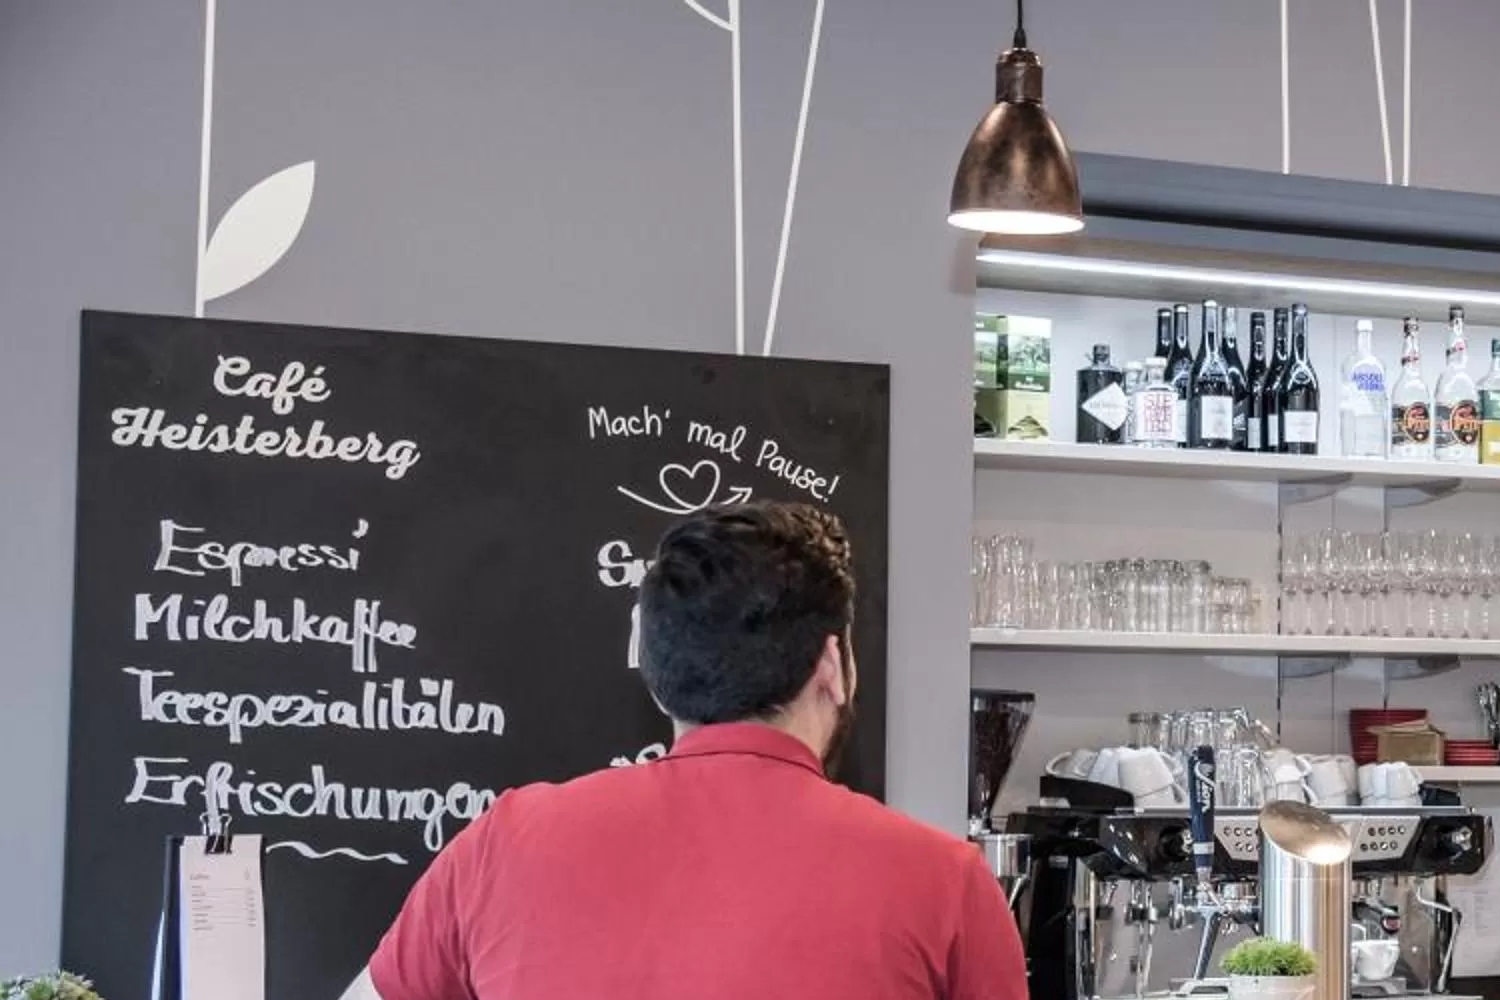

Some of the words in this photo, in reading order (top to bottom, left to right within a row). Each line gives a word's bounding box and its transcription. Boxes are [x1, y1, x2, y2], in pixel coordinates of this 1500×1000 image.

[213, 353, 331, 415] Café
[111, 407, 420, 480] Heisterberg
[588, 405, 671, 439] Mach'
[688, 421, 746, 462] mal
[756, 439, 839, 502] Pause!
[135, 593, 416, 673] Milchkaffee
[122, 667, 504, 744] Teespezialitäten
